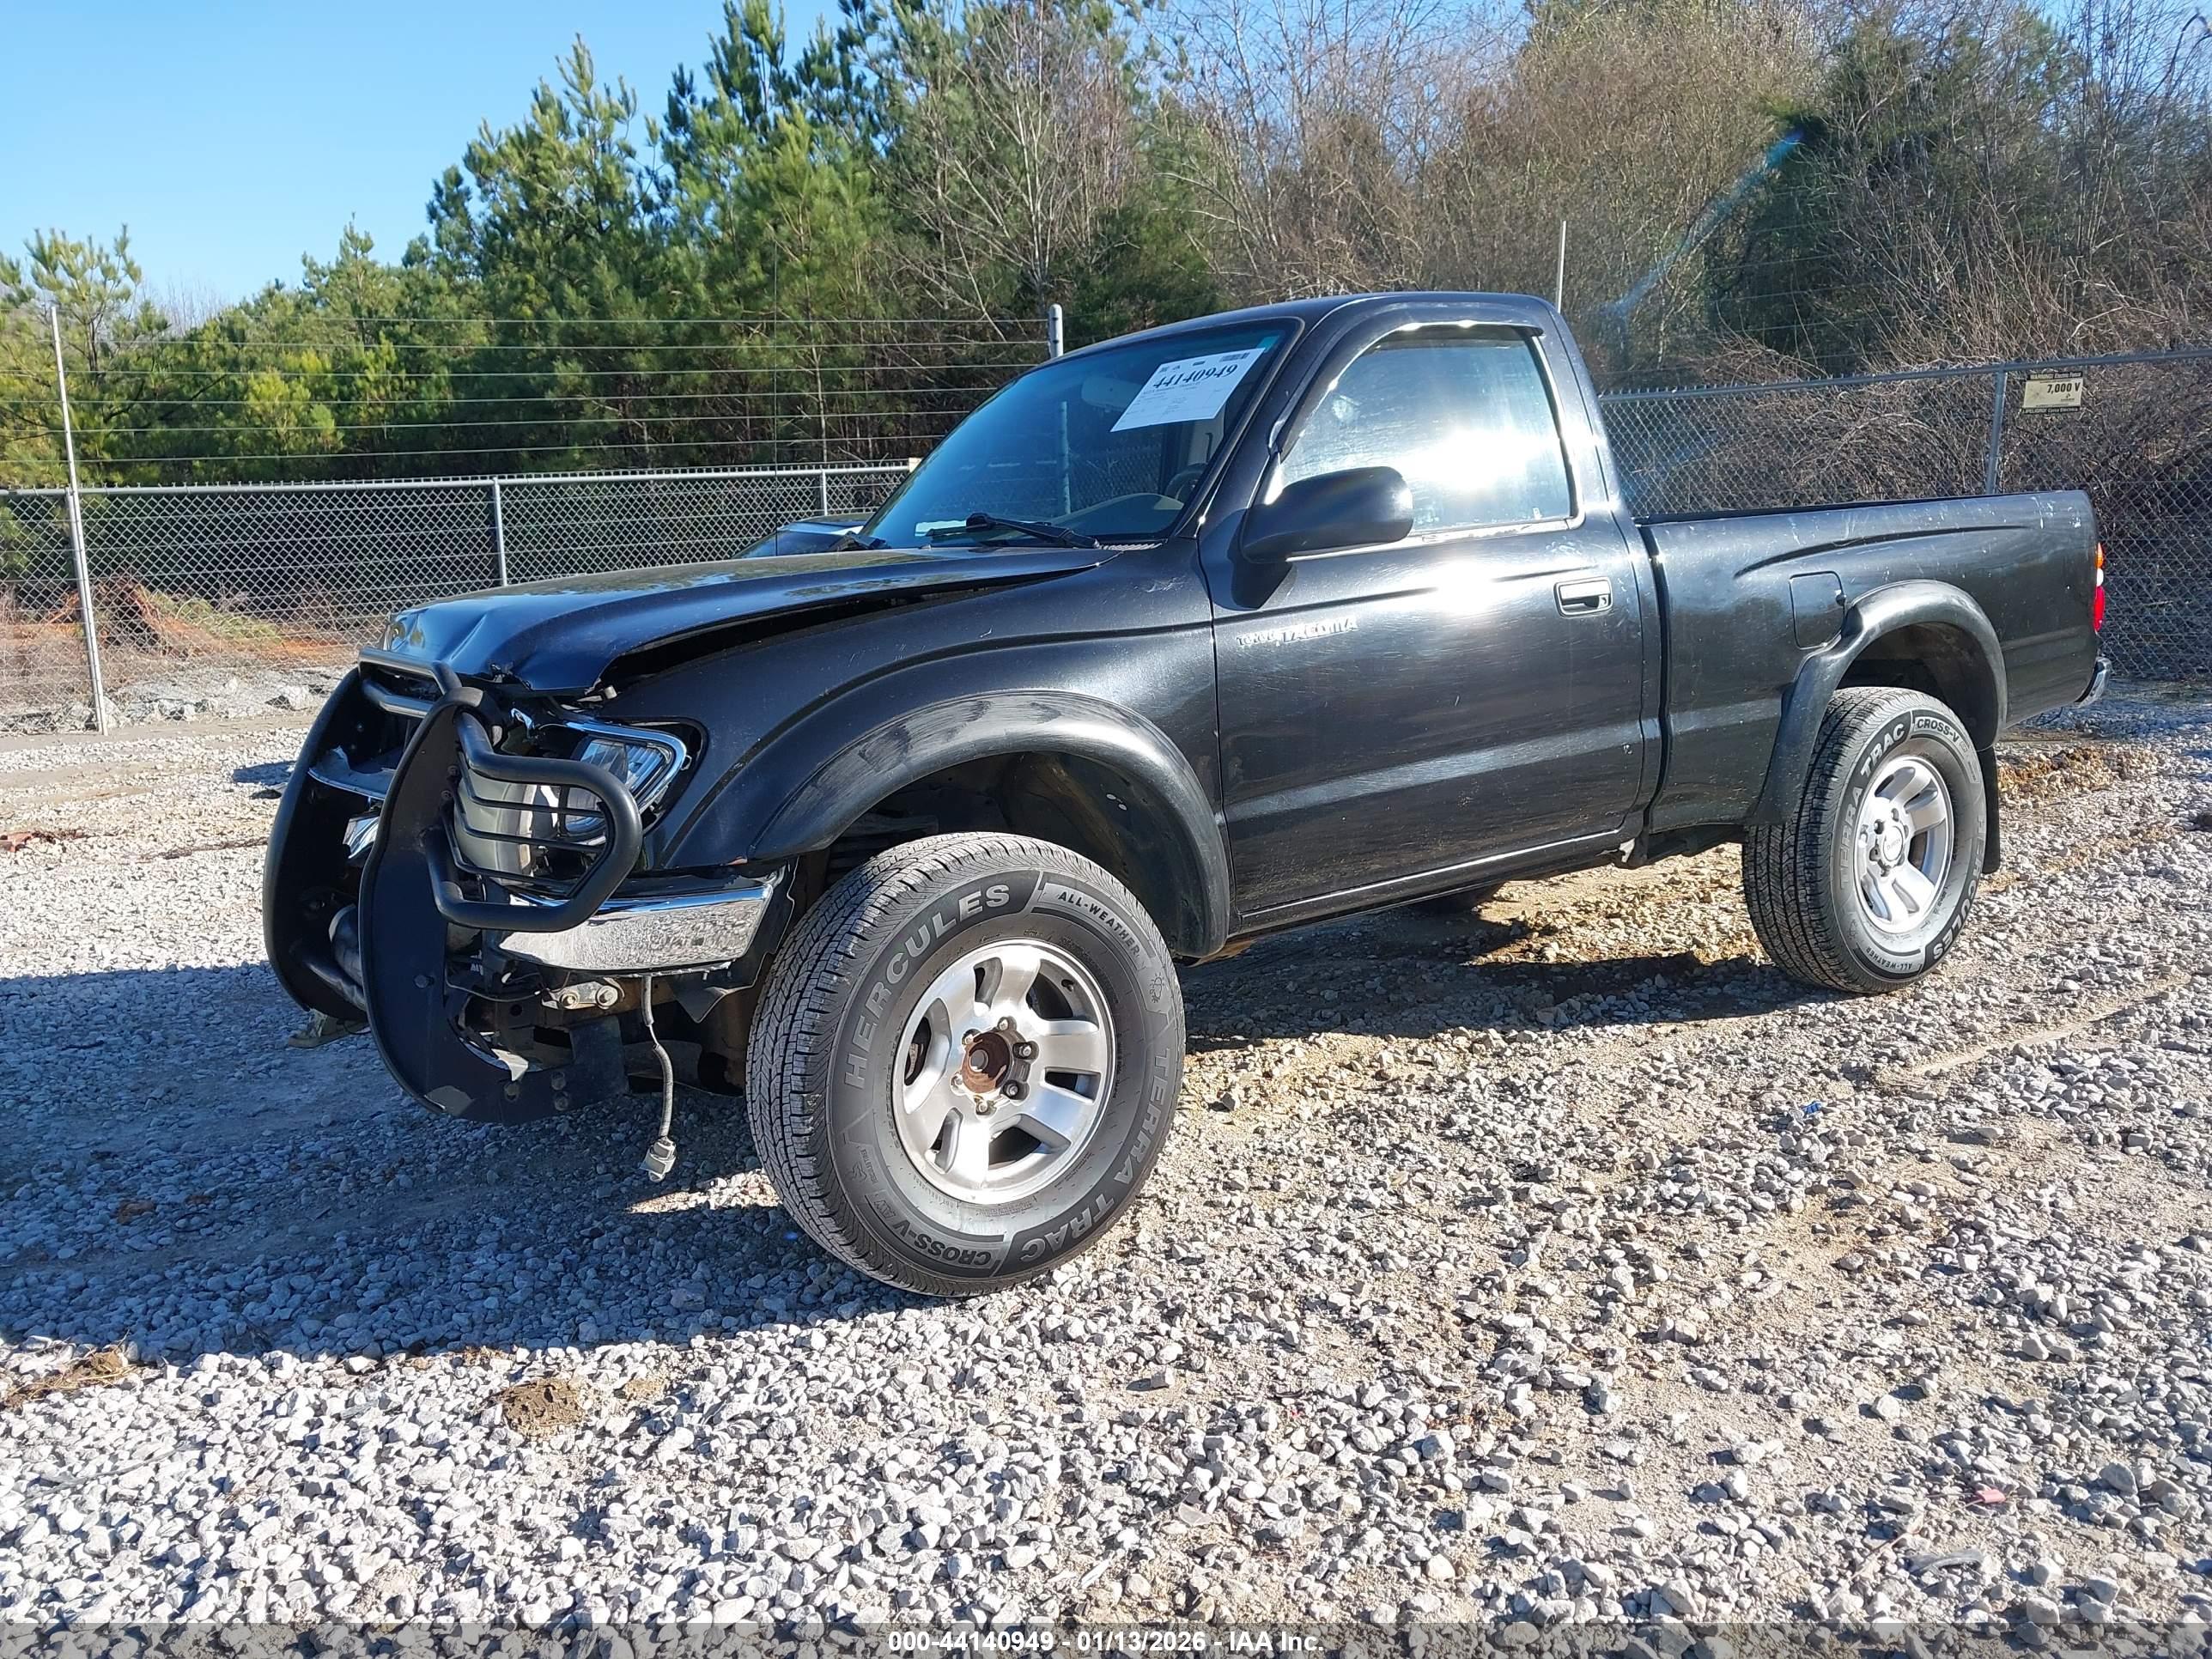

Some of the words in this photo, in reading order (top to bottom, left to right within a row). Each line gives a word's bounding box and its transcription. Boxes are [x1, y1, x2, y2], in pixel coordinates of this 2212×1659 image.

[1153, 363, 1238, 388] 44140949
[2047, 383, 2072, 394] 7,000
[2075, 382, 2081, 392] V
[1917, 718, 1960, 743] CROSS-V
[1840, 787, 1863, 890] TERRA
[1860, 723, 1905, 778] TRAC
[1057, 890, 1140, 957] ALL-WEATHER
[1865, 945, 1912, 969] ALL-WEATHER
[844, 884, 1010, 1090] HERCULES
[1114, 1047, 1170, 1184] TERRA
[893, 1219, 992, 1266] CROSS-V
[1020, 1193, 1115, 1262] TRAC
